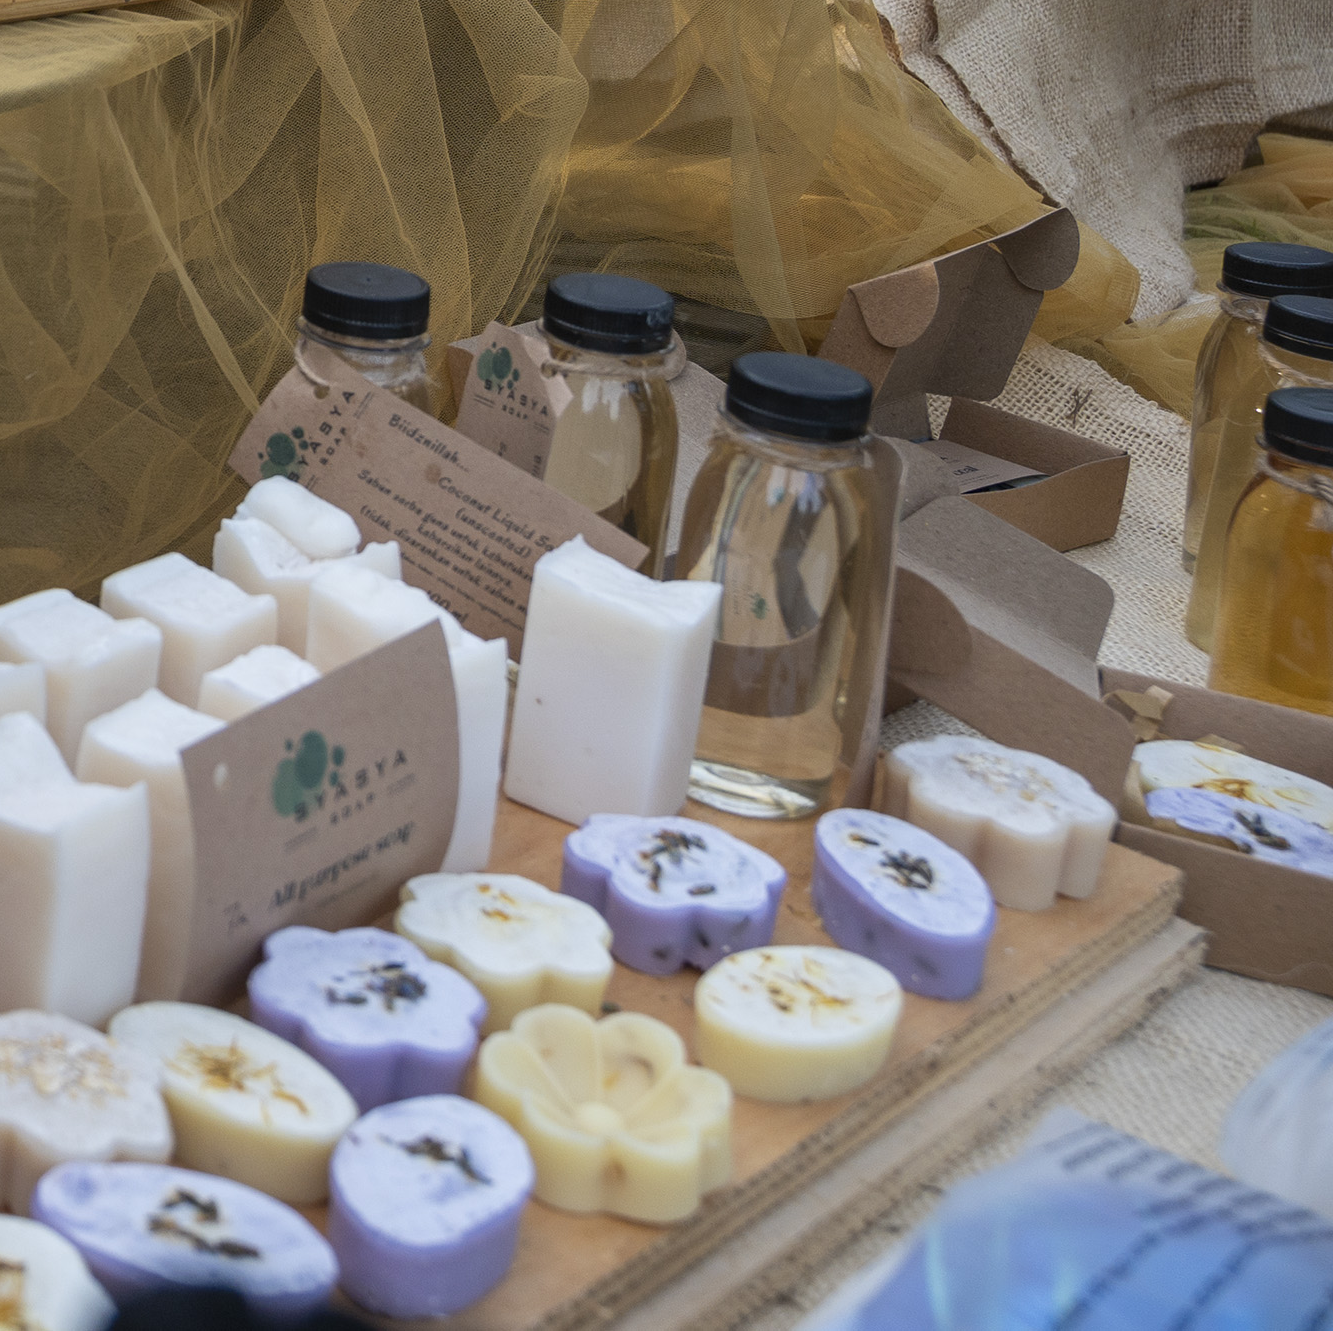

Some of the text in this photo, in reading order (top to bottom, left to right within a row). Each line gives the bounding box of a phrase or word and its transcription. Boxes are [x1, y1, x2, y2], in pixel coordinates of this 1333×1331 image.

[484, 378, 548, 417] SYASYA
[357, 469, 392, 496] Sabun
[438, 476, 492, 514] Coconut
[492, 507, 536, 542] Liquid
